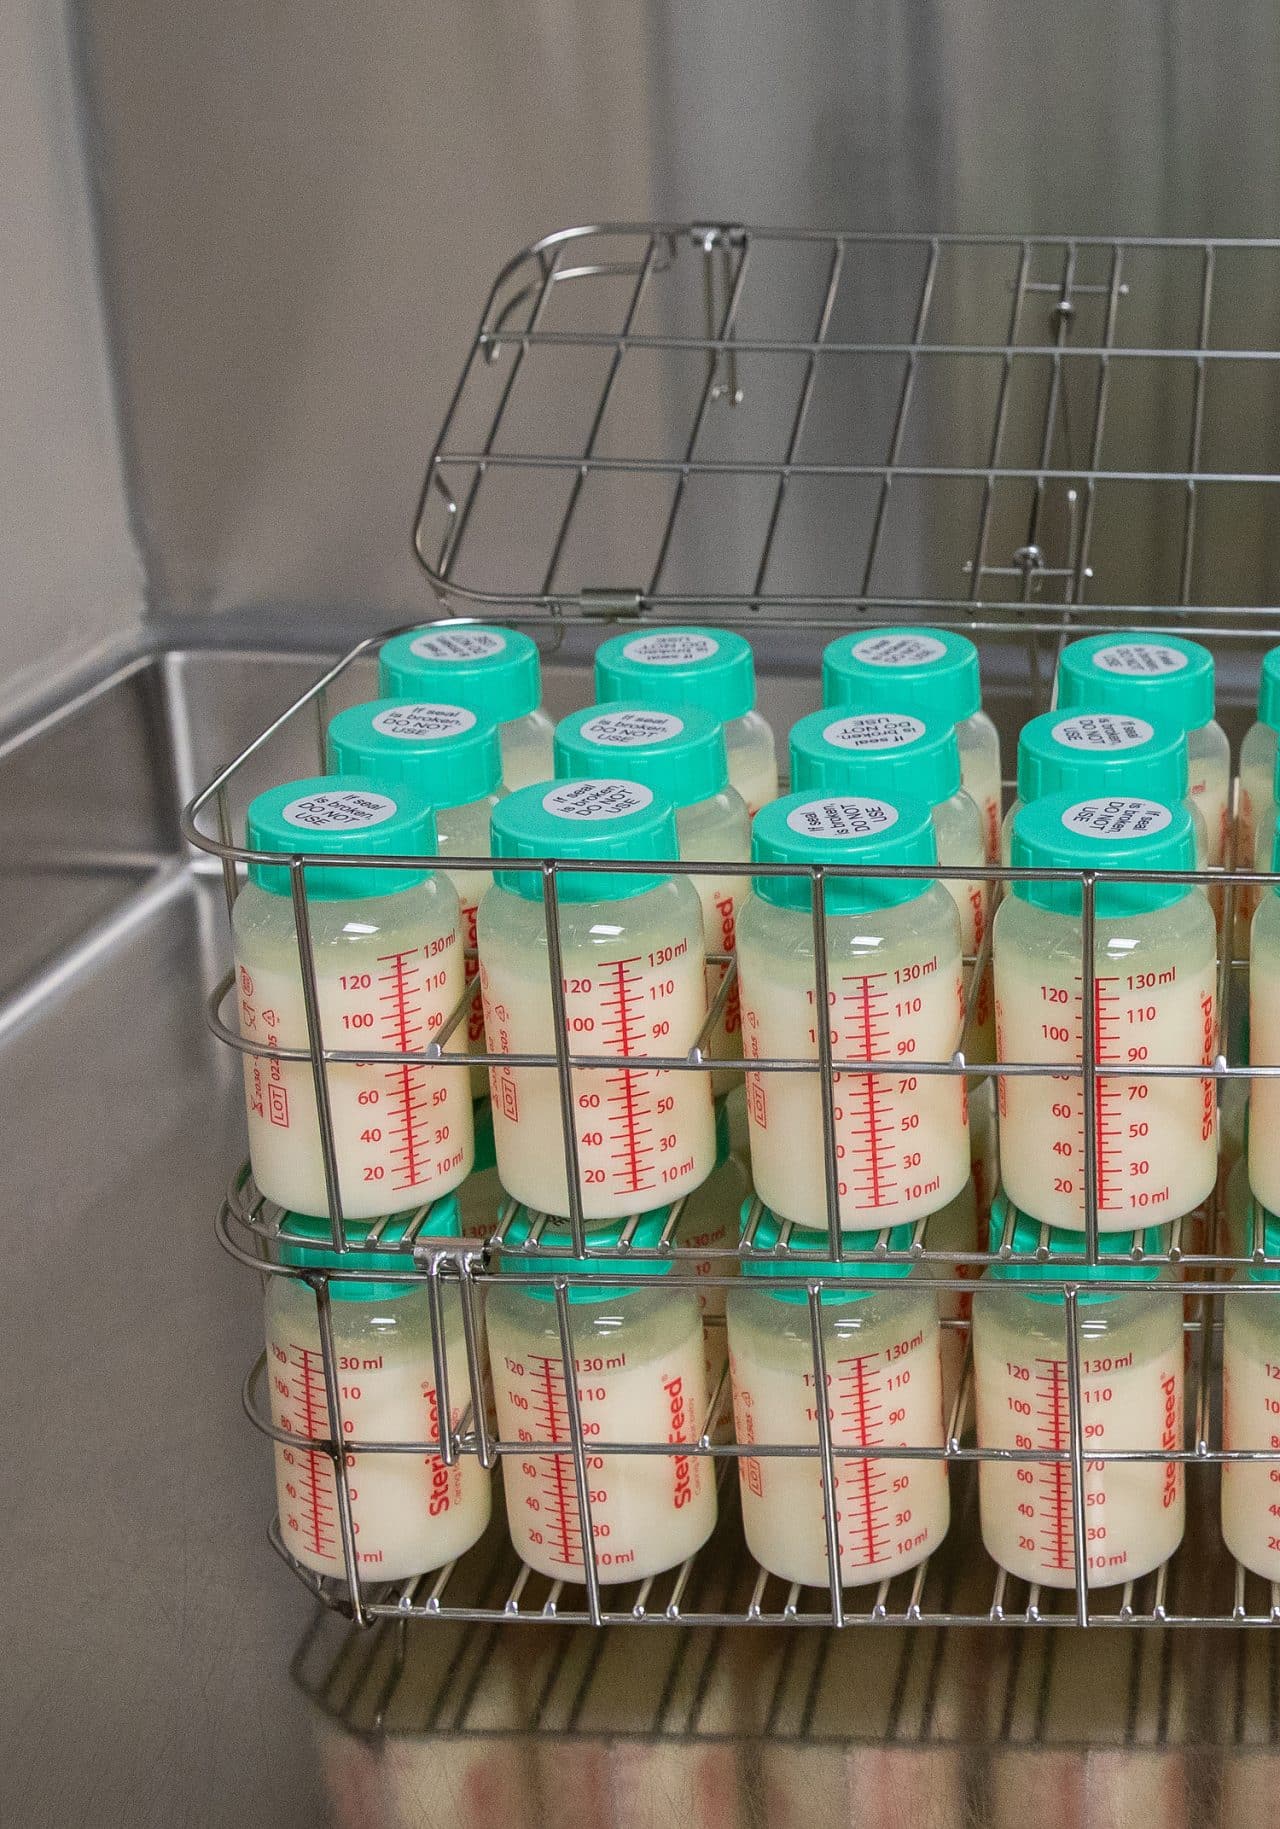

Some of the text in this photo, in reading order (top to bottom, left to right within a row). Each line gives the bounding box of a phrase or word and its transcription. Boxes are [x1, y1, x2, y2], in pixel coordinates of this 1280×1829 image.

[567, 784, 596, 798] seal
[353, 799, 386, 810] seal
[576, 789, 632, 816] DO NOT
[605, 799, 640, 813] USE
[295, 812, 330, 825] USE
[298, 803, 360, 823] DO NOT
[1073, 807, 1098, 822] USE
[1090, 802, 1125, 830] DO NOT
[1133, 816, 1152, 830] seal
[424, 929, 456, 958] 130 ml
[648, 938, 688, 967] 130 ml
[894, 956, 937, 984] 130 ml
[1127, 966, 1176, 990] 130 ml
[340, 974, 372, 990] 120
[426, 971, 446, 992] 110
[650, 980, 674, 1000] 110
[1040, 987, 1068, 1003] 120
[895, 998, 921, 1017] 110
[1127, 1007, 1156, 1022] 110
[342, 1014, 374, 1028] 100
[428, 1012, 443, 1028] 90
[652, 1022, 670, 1038] 90
[1041, 1025, 1069, 1041] 100
[897, 1039, 915, 1055] 90
[1128, 1047, 1148, 1061] 90
[899, 1077, 917, 1094] 70
[1128, 1085, 1148, 1100] 70
[358, 1091, 379, 1105] 60
[432, 1088, 447, 1106] 50
[579, 1095, 600, 1108] 60
[657, 1097, 674, 1113] 50
[1052, 1103, 1071, 1118] 60
[901, 1115, 919, 1130] 50
[1129, 1123, 1148, 1137] 50
[360, 1129, 382, 1142] 40
[435, 1126, 450, 1144] 30
[582, 1132, 603, 1145] 40
[660, 1135, 676, 1151] 30
[1053, 1141, 1072, 1156] 40
[437, 1148, 464, 1176] 10 ml
[903, 1153, 921, 1168] 30
[1130, 1161, 1149, 1175] 30
[364, 1167, 384, 1180] 20
[584, 1170, 605, 1183] 20
[662, 1158, 694, 1182] 10 ml
[904, 1176, 940, 1201] 10 ml
[1054, 1178, 1072, 1193] 20
[1130, 1187, 1169, 1207] 10 ml
[886, 1342, 908, 1361] 130
[504, 1358, 524, 1375] 120
[607, 1354, 626, 1368] ml
[1084, 1353, 1132, 1374] 130 ml
[1006, 1363, 1029, 1381] 120
[887, 1371, 910, 1391] 110
[1084, 1389, 1112, 1403] 110
[1008, 1397, 1031, 1415] 100
[1085, 1425, 1104, 1437] 90
[522, 1463, 536, 1477] 60
[1017, 1469, 1033, 1483] 60
[1087, 1493, 1105, 1505] 50
[1087, 1527, 1106, 1539] 30
